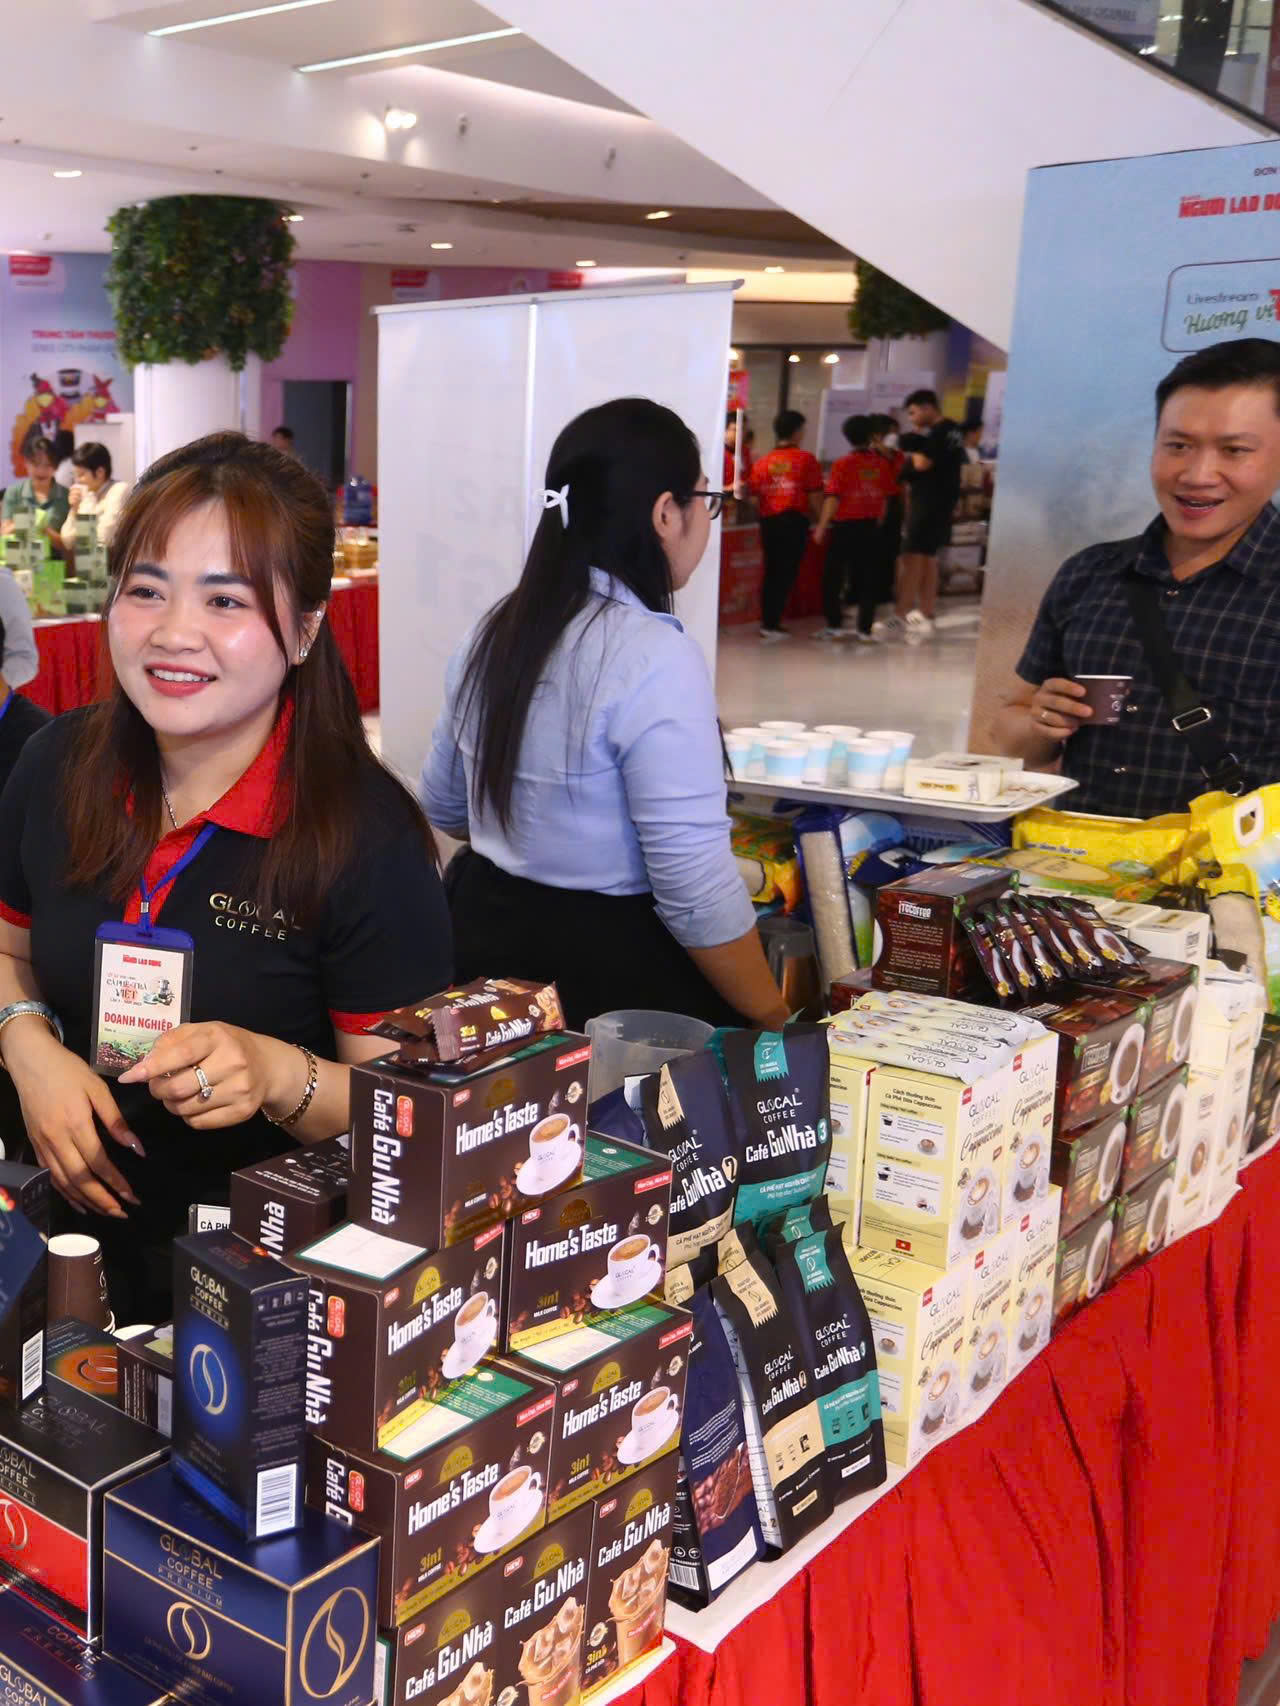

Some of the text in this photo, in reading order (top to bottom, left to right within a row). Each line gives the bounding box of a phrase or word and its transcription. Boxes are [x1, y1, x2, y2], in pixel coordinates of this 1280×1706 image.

[1230, 194, 1261, 214] LAO
[1186, 292, 1259, 305] Livestream
[214, 915, 287, 941] COFFEE
[104, 1012, 173, 1032] DOANH NGHIỆP
[456, 1102, 538, 1155] Home's Taste
[763, 1110, 796, 1124] COFFEE
[371, 1089, 402, 1225] Café Gu Nhà
[676, 1152, 699, 1172] COFFEE
[745, 1143, 769, 1164] Café
[819, 1121, 827, 1141] 3
[200, 1218, 231, 1231] CÀ PH
[670, 1195, 687, 1213] afé
[260, 1201, 285, 1251] Nhà
[525, 1222, 618, 1270] Home's Taste
[191, 1266, 228, 1302] GLOBAL
[195, 1286, 223, 1312] COFFEE
[388, 1286, 462, 1356] Home's Taste
[820, 1331, 847, 1348] COFFEE
[768, 1363, 791, 1382] COFFEE
[305, 1371, 332, 1424] Nhà
[562, 1393, 608, 1439] Home's
[609, 1380, 642, 1412] Taste
[326, 1458, 345, 1502] Café
[408, 1463, 499, 1536] Home's Taste
[159, 1534, 223, 1579] GLOBAL
[598, 1502, 671, 1568] Café Gu Nhà
[167, 1557, 213, 1590] COFFEE
[504, 1557, 585, 1629] Café Gu Nhà
[405, 1620, 493, 1700] Café Gu Nhà
